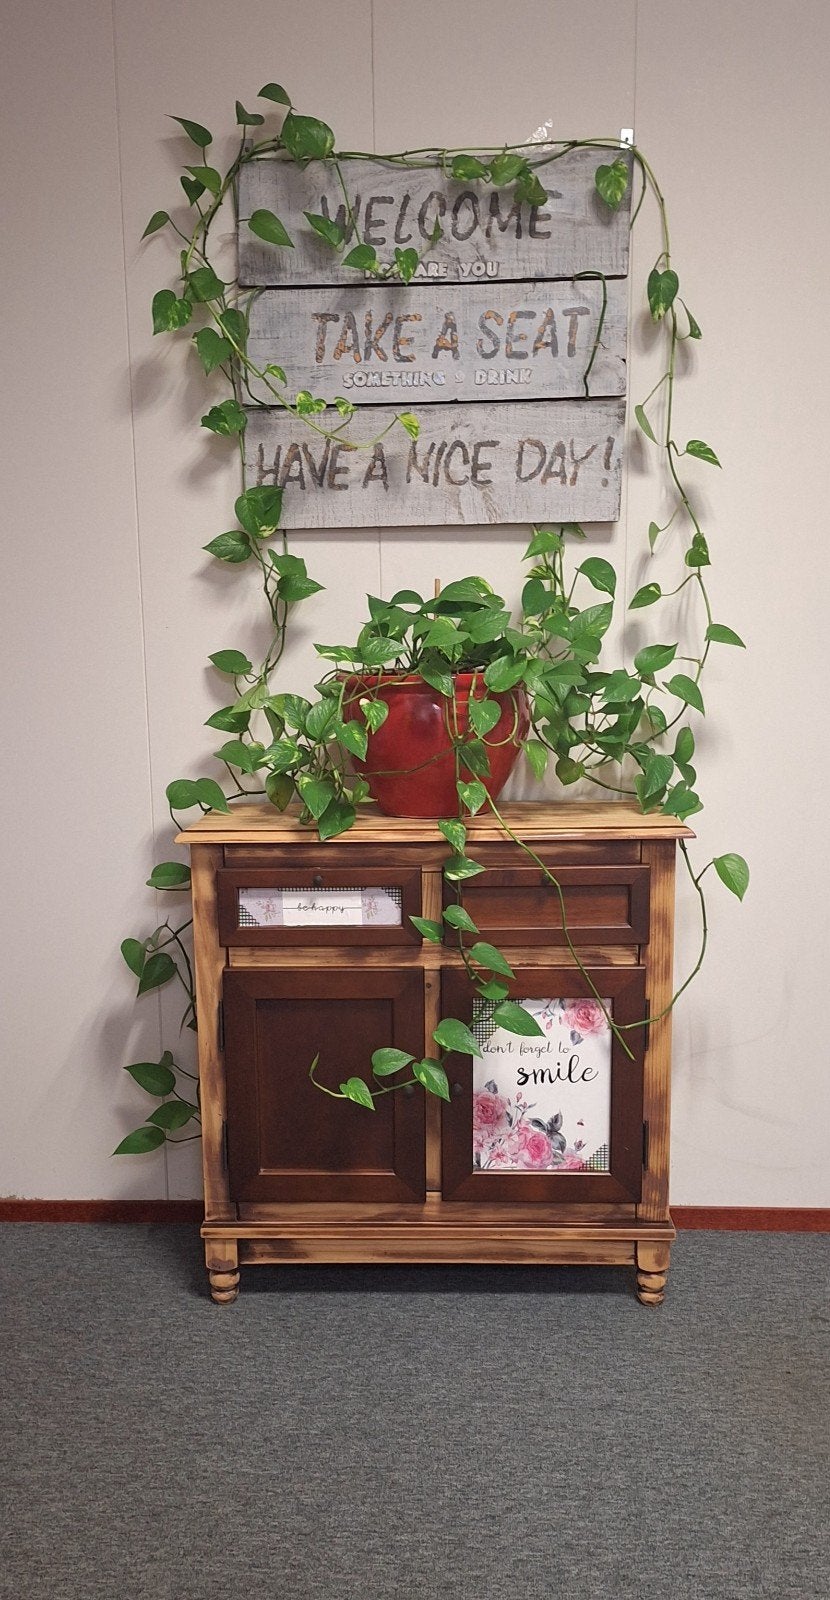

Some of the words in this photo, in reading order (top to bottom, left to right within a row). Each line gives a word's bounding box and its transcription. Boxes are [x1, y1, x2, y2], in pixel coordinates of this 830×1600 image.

[320, 190, 563, 246] WELCOME
[414, 260, 449, 278] ARE
[460, 261, 500, 278] YOU
[311, 309, 423, 364] TAKE
[431, 310, 461, 360] A
[476, 305, 591, 361] SEAT
[342, 370, 446, 389] SOMETHING
[474, 367, 533, 386] DRINK
[255, 436, 358, 491] HAVE
[362, 442, 390, 493] A
[406, 438, 501, 488] NICE
[482, 1041, 515, 1054] don't
[519, 1041, 553, 1058] forget
[558, 1041, 571, 1054] to
[516, 1054, 599, 1086] smile
